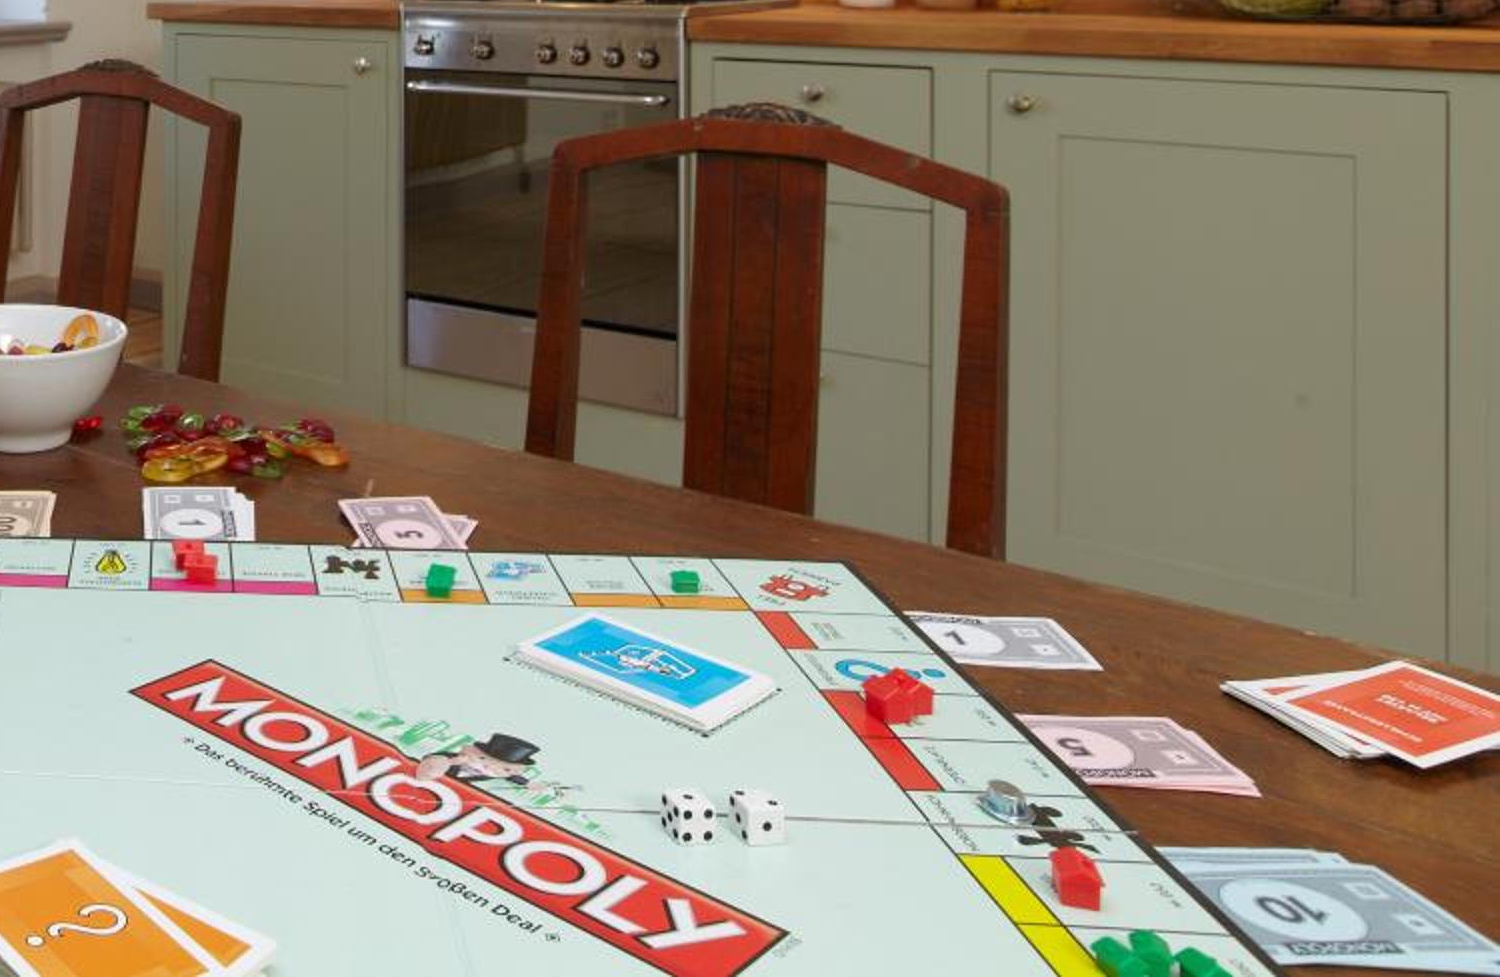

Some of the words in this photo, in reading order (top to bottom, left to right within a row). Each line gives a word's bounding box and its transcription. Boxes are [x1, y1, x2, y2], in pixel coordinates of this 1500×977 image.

[395, 530, 424, 541] 5
[944, 631, 966, 645] 1
[1058, 738, 1094, 757] 5
[165, 676, 747, 949] MONOPOLY
[194, 742, 226, 761] Das
[226, 753, 304, 807] berühmte
[301, 799, 350, 831] Spiel
[347, 827, 378, 847] um
[378, 838, 418, 869] den
[490, 903, 543, 936] Deal
[1256, 896, 1329, 926] 10
